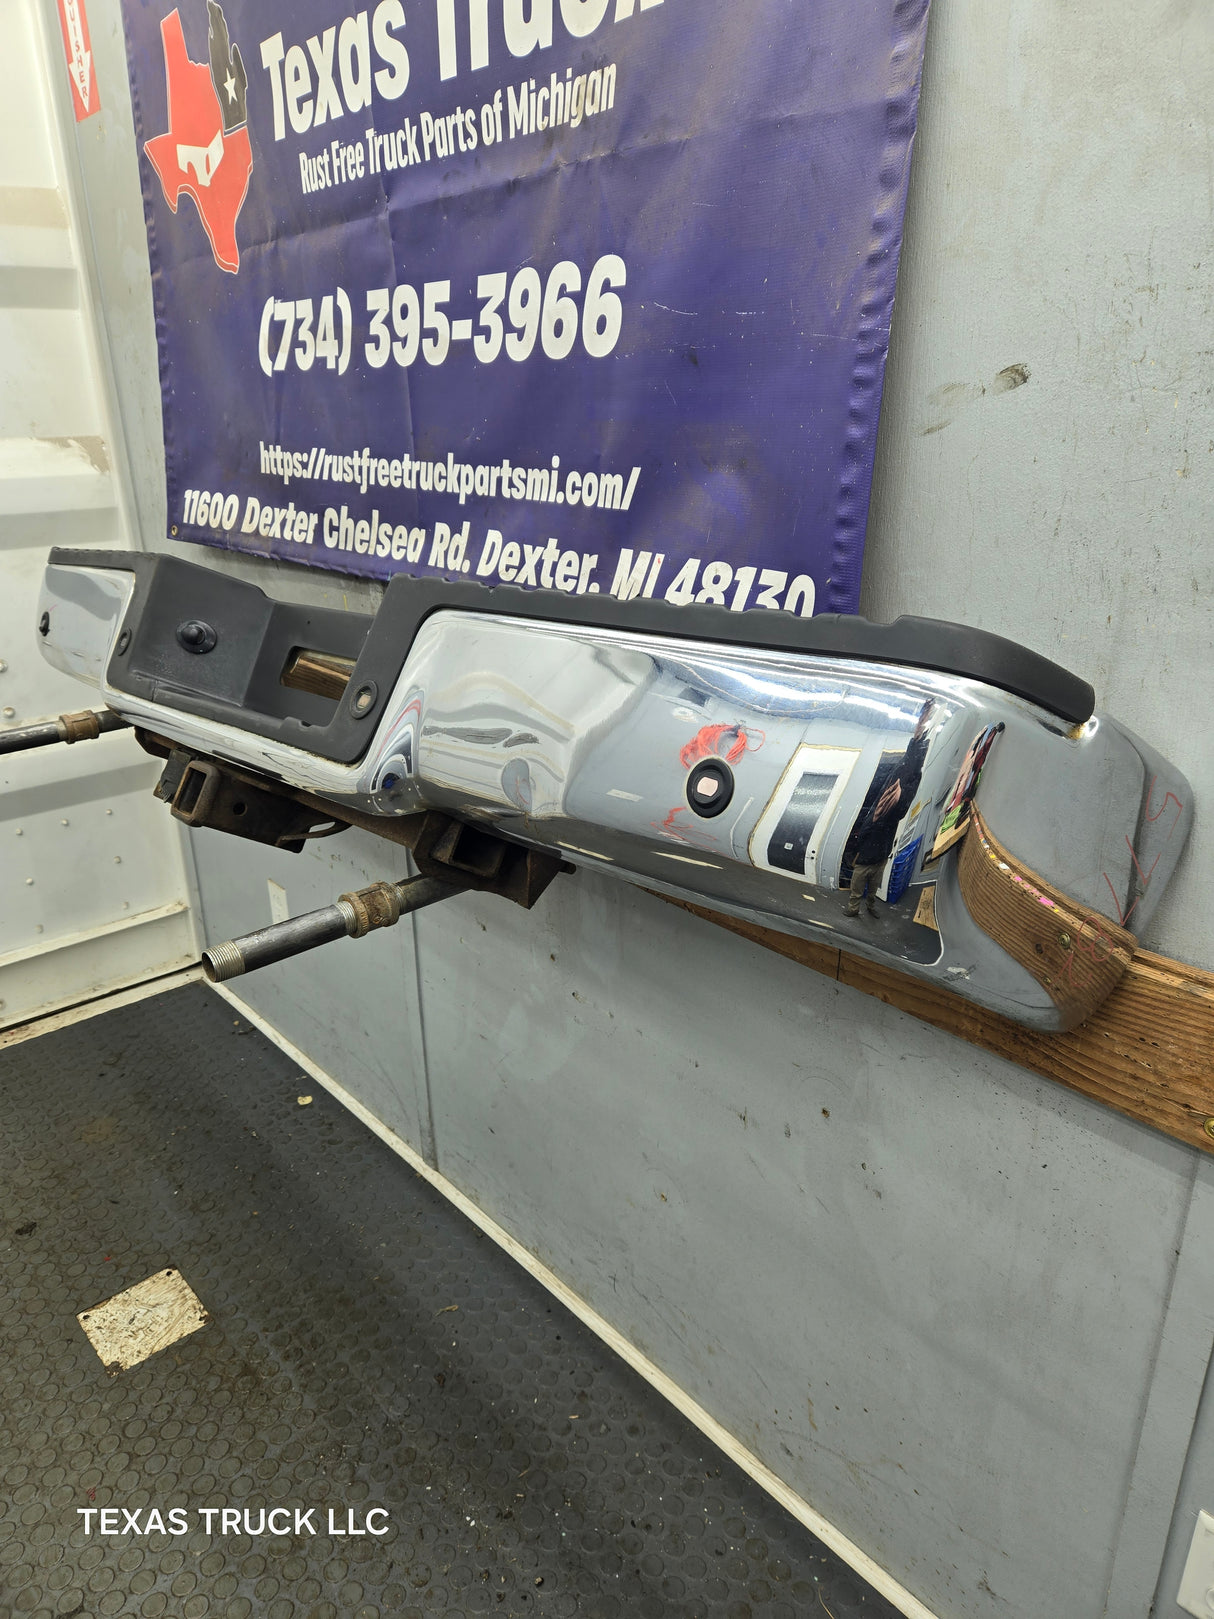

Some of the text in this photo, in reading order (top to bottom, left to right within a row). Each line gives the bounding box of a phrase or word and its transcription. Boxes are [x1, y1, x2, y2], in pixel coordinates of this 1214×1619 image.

[259, 0, 665, 141] Texas Tru
[299, 63, 617, 194] Rust Free Truck Parts of Michigan
[258, 254, 627, 377] (734) 395-3966
[259, 440, 641, 511] https://rustfreetruckpartsmi.com/
[183, 489, 239, 530] 11600
[240, 496, 318, 544] Dexter
[322, 505, 426, 564] Chelsea
[428, 521, 471, 573] Rd.
[609, 548, 665, 600] MI
[664, 558, 815, 618] 48130
